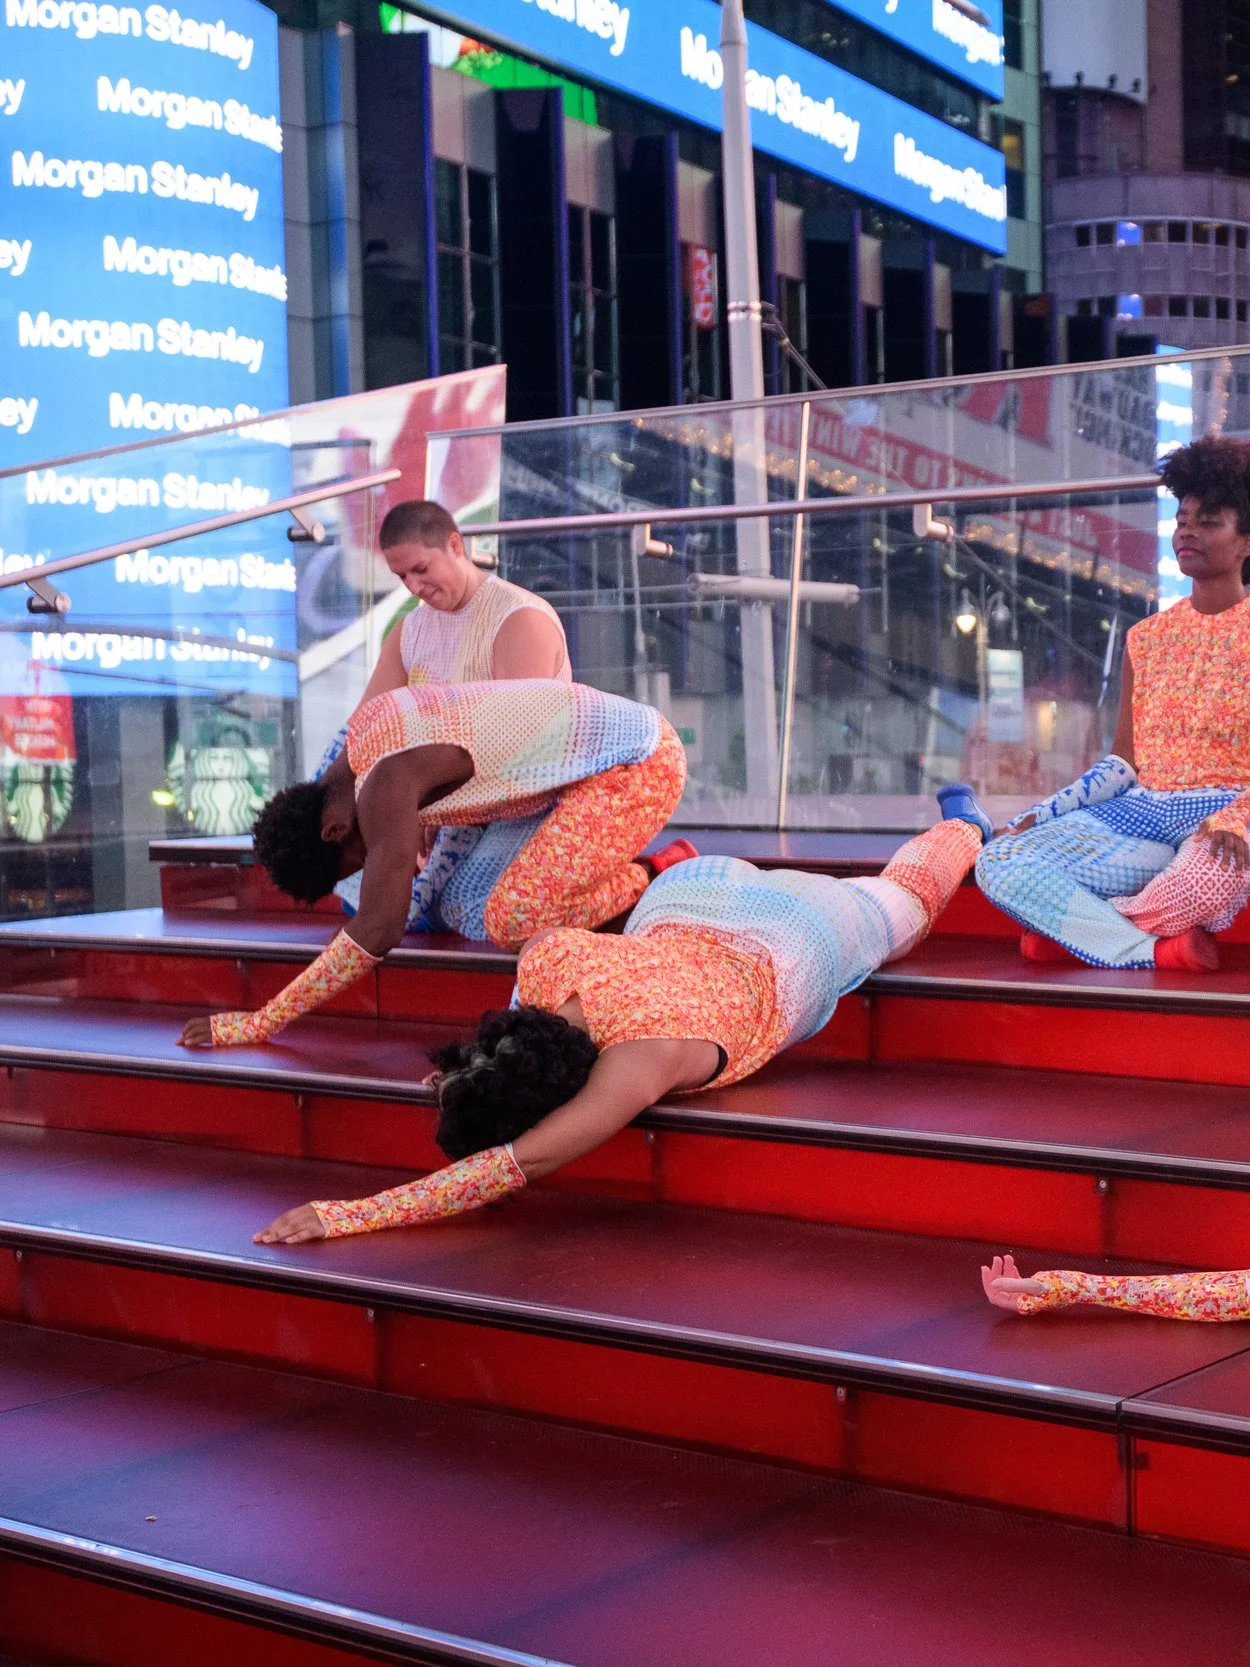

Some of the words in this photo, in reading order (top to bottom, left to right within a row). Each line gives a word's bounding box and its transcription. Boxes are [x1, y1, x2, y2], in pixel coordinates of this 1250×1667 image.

[5, 0, 142, 39] Morgan
[145, 4, 254, 71] Stanley
[97, 75, 222, 130] Morgan
[680, 26, 776, 117] Moan
[775, 74, 860, 164] Stanley
[11, 150, 148, 198] Morgan
[150, 160, 259, 222] Stanley
[103, 235, 228, 287] Morgan
[18, 311, 154, 358] Morgan
[156, 317, 264, 374] Stanley
[109, 392, 236, 436] Morgan
[26, 469, 161, 514] Morgan
[115, 548, 239, 593] Morgan
[31, 631, 165, 669] Morgan
